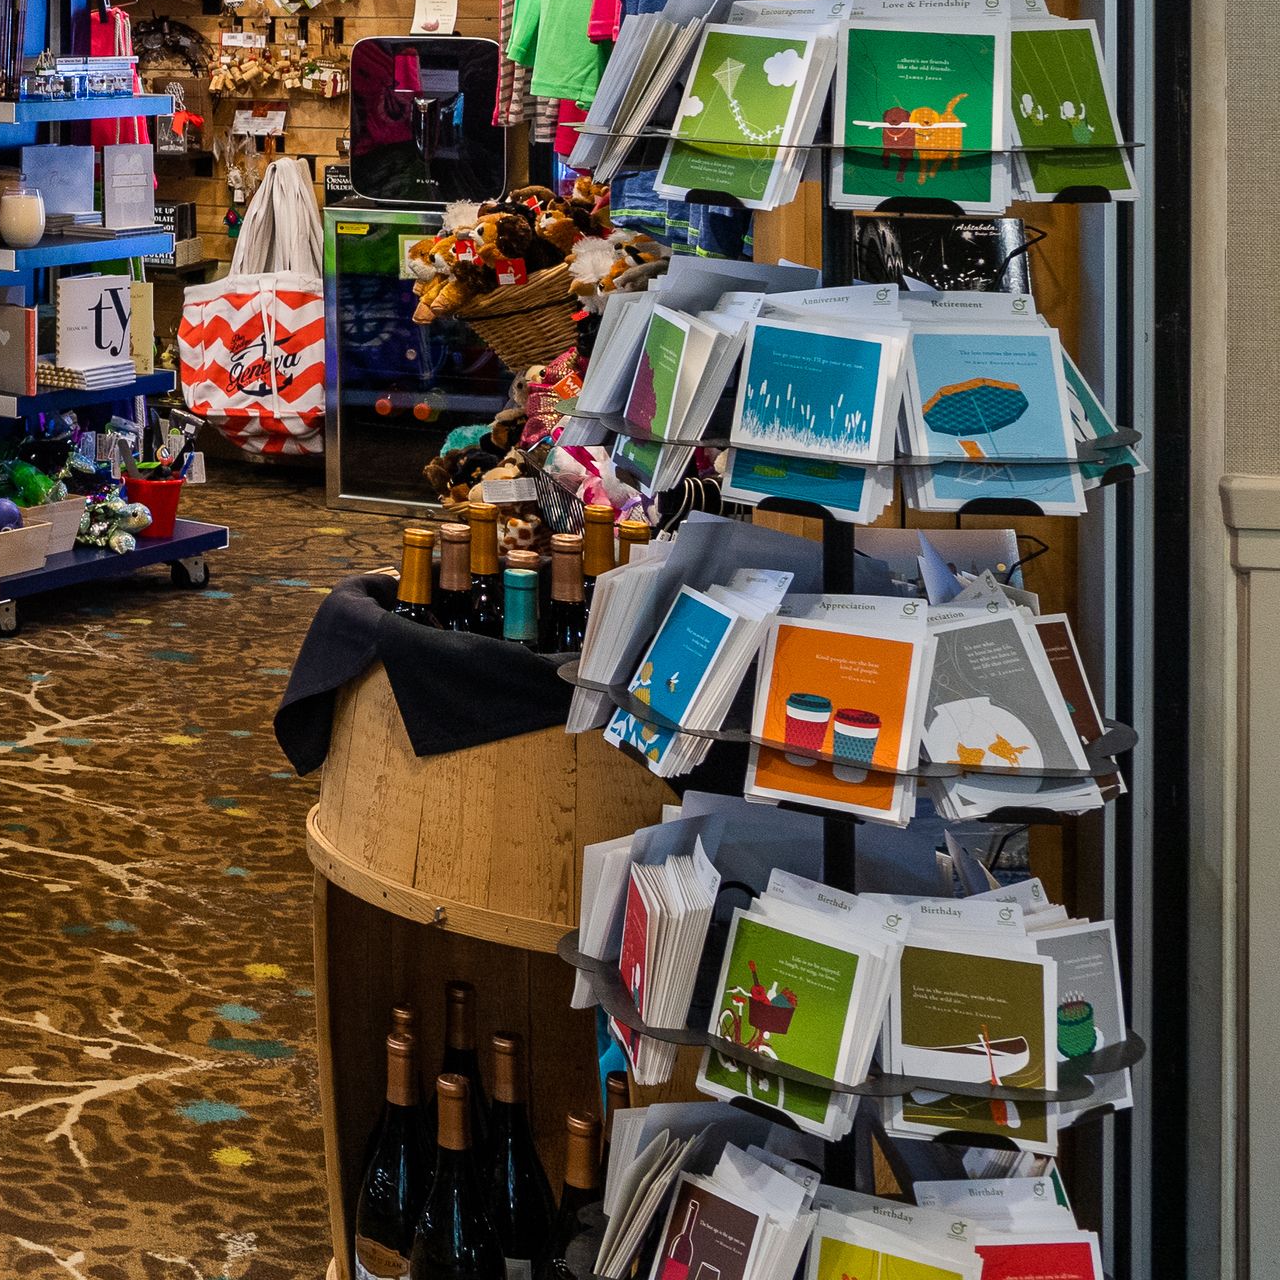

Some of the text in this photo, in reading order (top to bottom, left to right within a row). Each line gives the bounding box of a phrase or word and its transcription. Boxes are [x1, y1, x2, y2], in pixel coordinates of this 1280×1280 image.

[882, 1, 905, 9] Love
[919, 0, 970, 9] Friendship
[760, 8, 815, 16] Encouragement
[802, 295, 850, 306] Anniversary
[931, 299, 983, 309] Retirement
[88, 287, 130, 357] ty
[819, 600, 876, 612] Appreciation
[817, 893, 853, 913] Birthday
[921, 905, 963, 918] Birthday
[969, 1187, 1005, 1198] Birthday
[871, 1205, 914, 1225] Birthday
